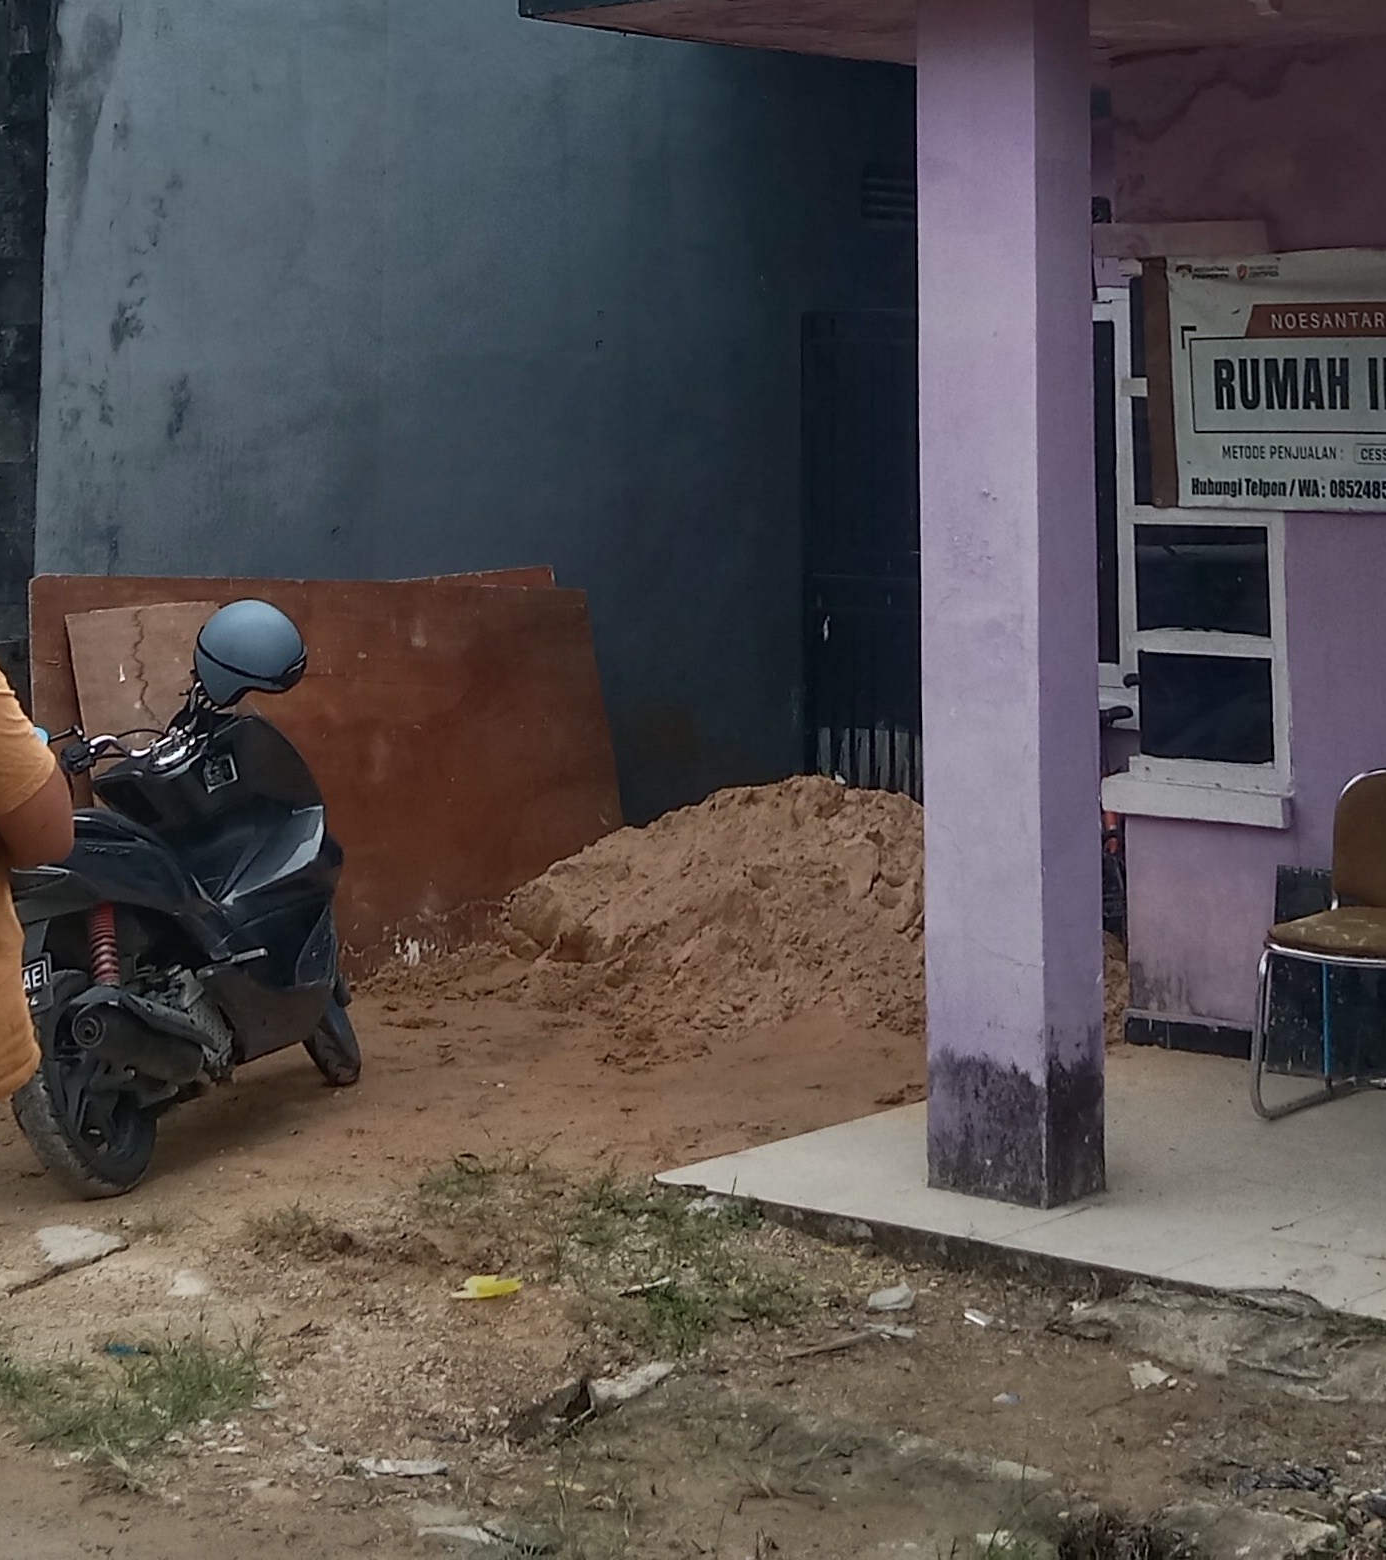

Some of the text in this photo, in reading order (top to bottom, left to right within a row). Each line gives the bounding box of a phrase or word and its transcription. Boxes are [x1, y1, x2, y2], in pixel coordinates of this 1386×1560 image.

[1213, 357, 1350, 410] RUMAH
[1222, 445, 1265, 460] METODE
[1269, 445, 1337, 460] PENJUALAN
[1191, 477, 1242, 499] Hubungi
[1245, 478, 1286, 499] Telpon
